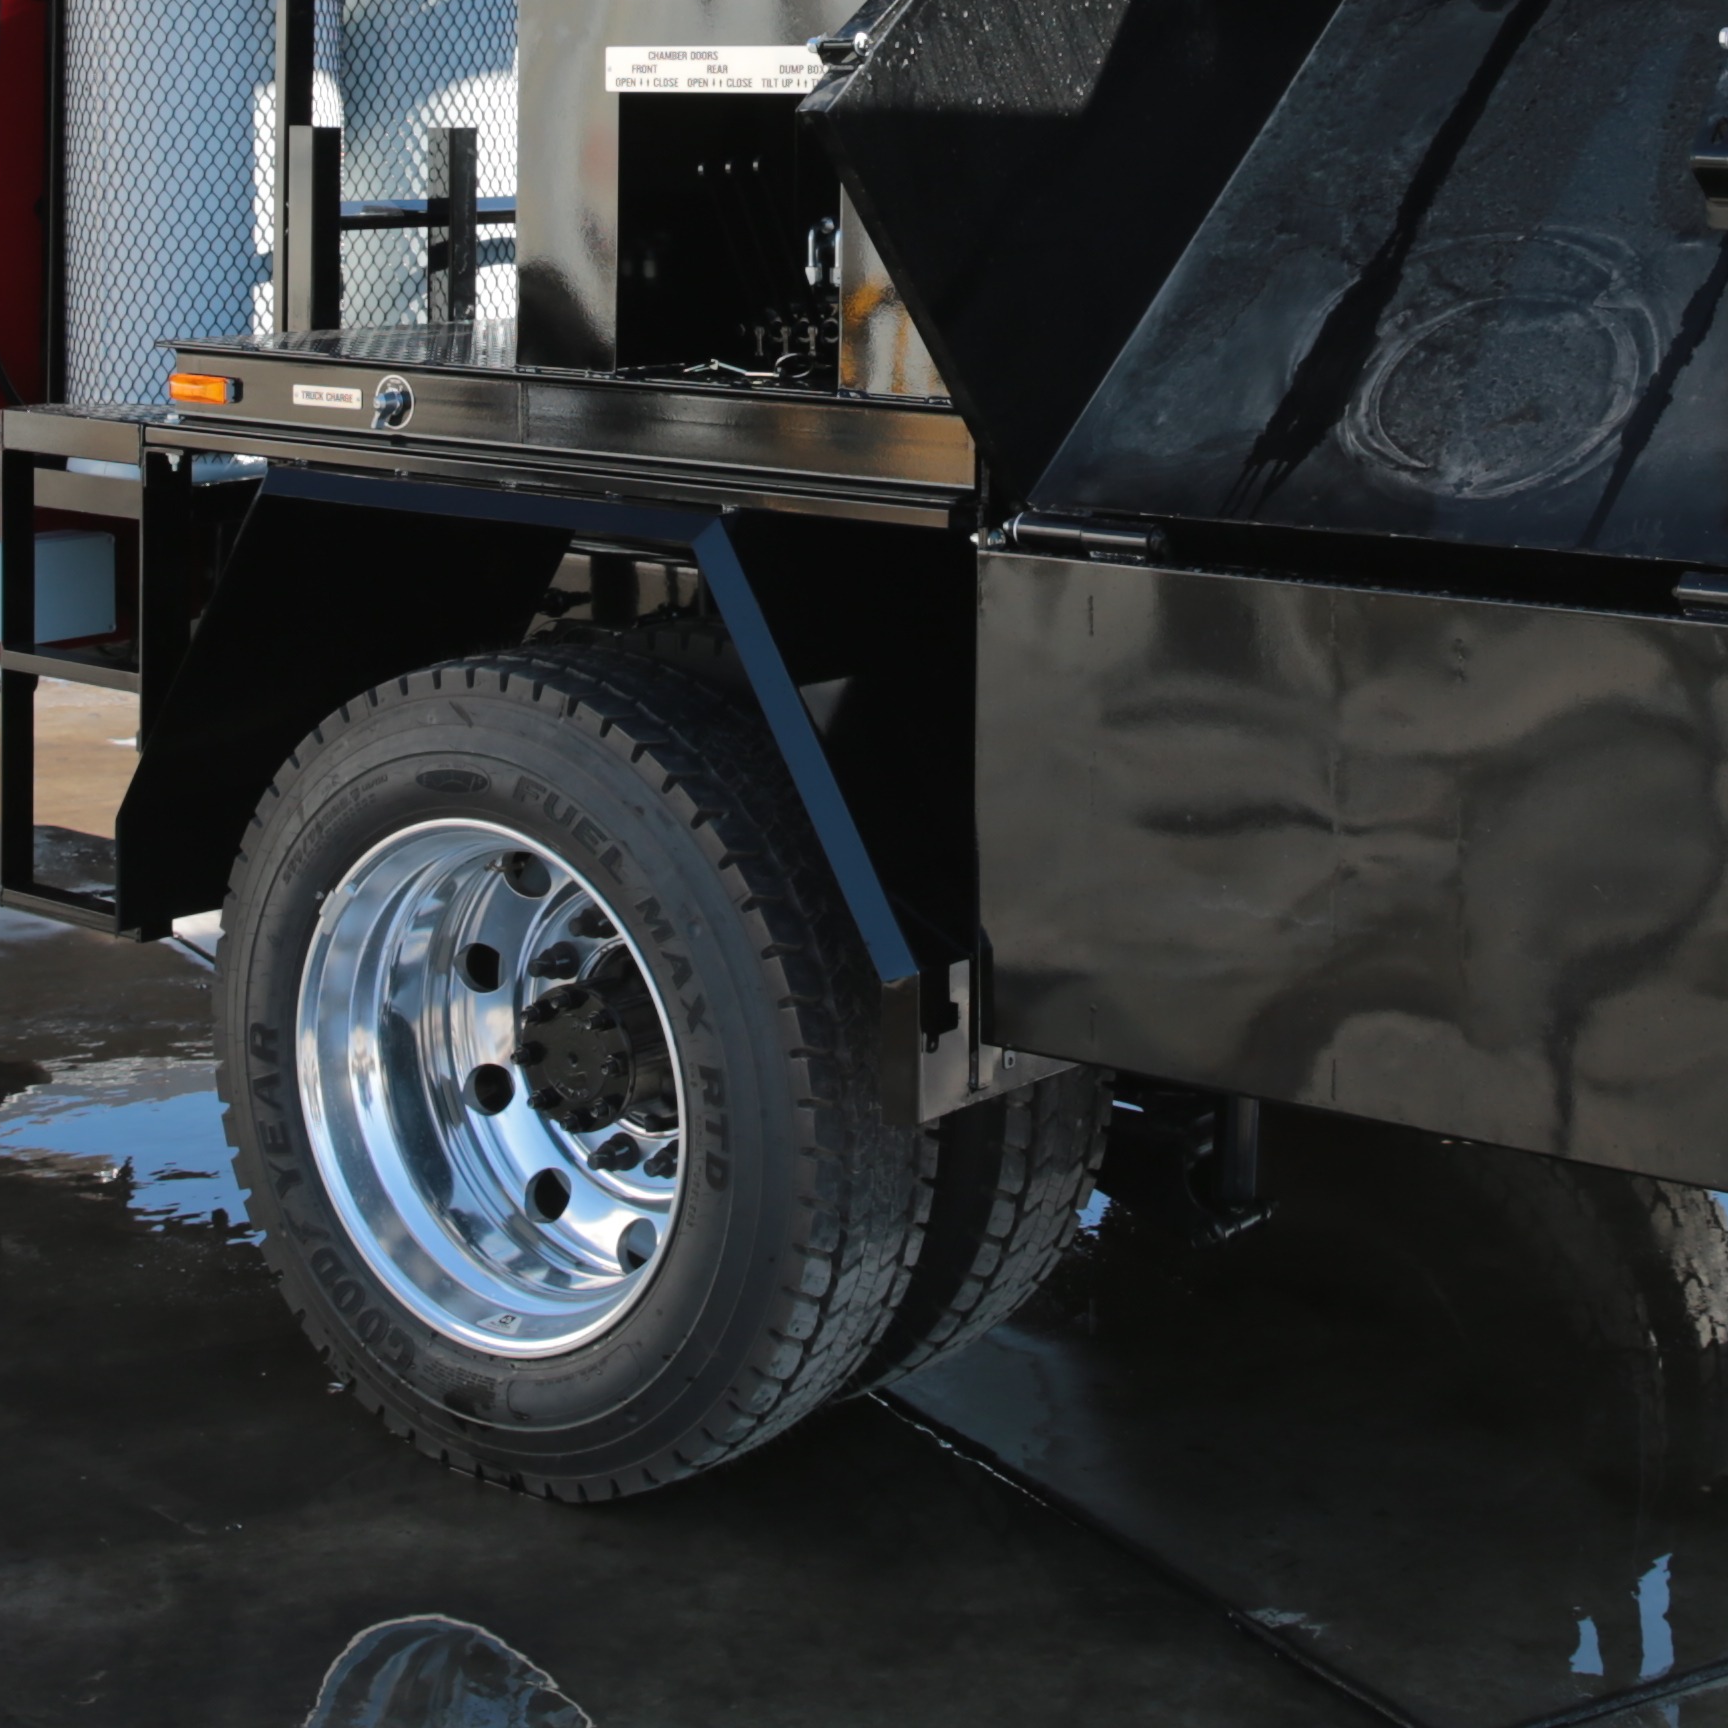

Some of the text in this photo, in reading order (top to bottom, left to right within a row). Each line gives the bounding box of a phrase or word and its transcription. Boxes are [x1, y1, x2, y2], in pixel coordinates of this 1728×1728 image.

[648, 51, 718, 60] CHAMBER DOORS
[632, 64, 657, 73] FRONT
[707, 64, 728, 74] REAR
[779, 64, 804, 74] DUMP
[615, 77, 679, 87] OPEN CLOSE
[687, 77, 752, 87] OPEN CLOSE
[762, 78, 793, 88] TILT UP
[302, 391, 353, 403] TRUCK CHARGE
[513, 774, 731, 1193] FUEL MAX RTD
[250, 1022, 416, 1374] GOODYEAR
